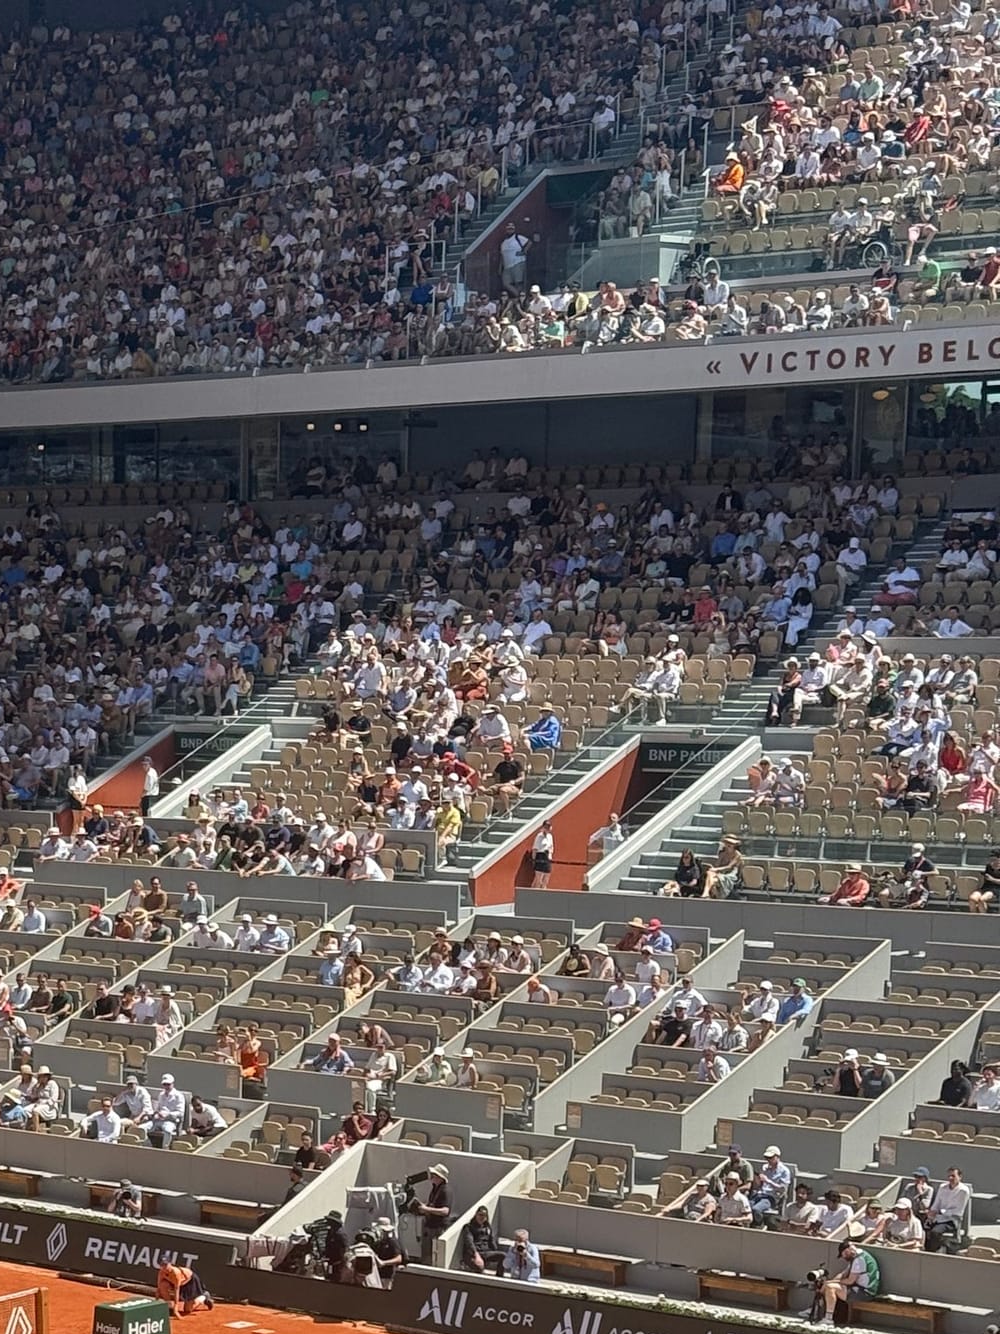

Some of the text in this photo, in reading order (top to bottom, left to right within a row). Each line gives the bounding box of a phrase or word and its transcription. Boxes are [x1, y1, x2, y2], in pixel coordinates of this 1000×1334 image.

[740, 344, 896, 374] VICTORY
[649, 749, 677, 761] BNP
[472, 1306, 535, 1328] ACCOR
